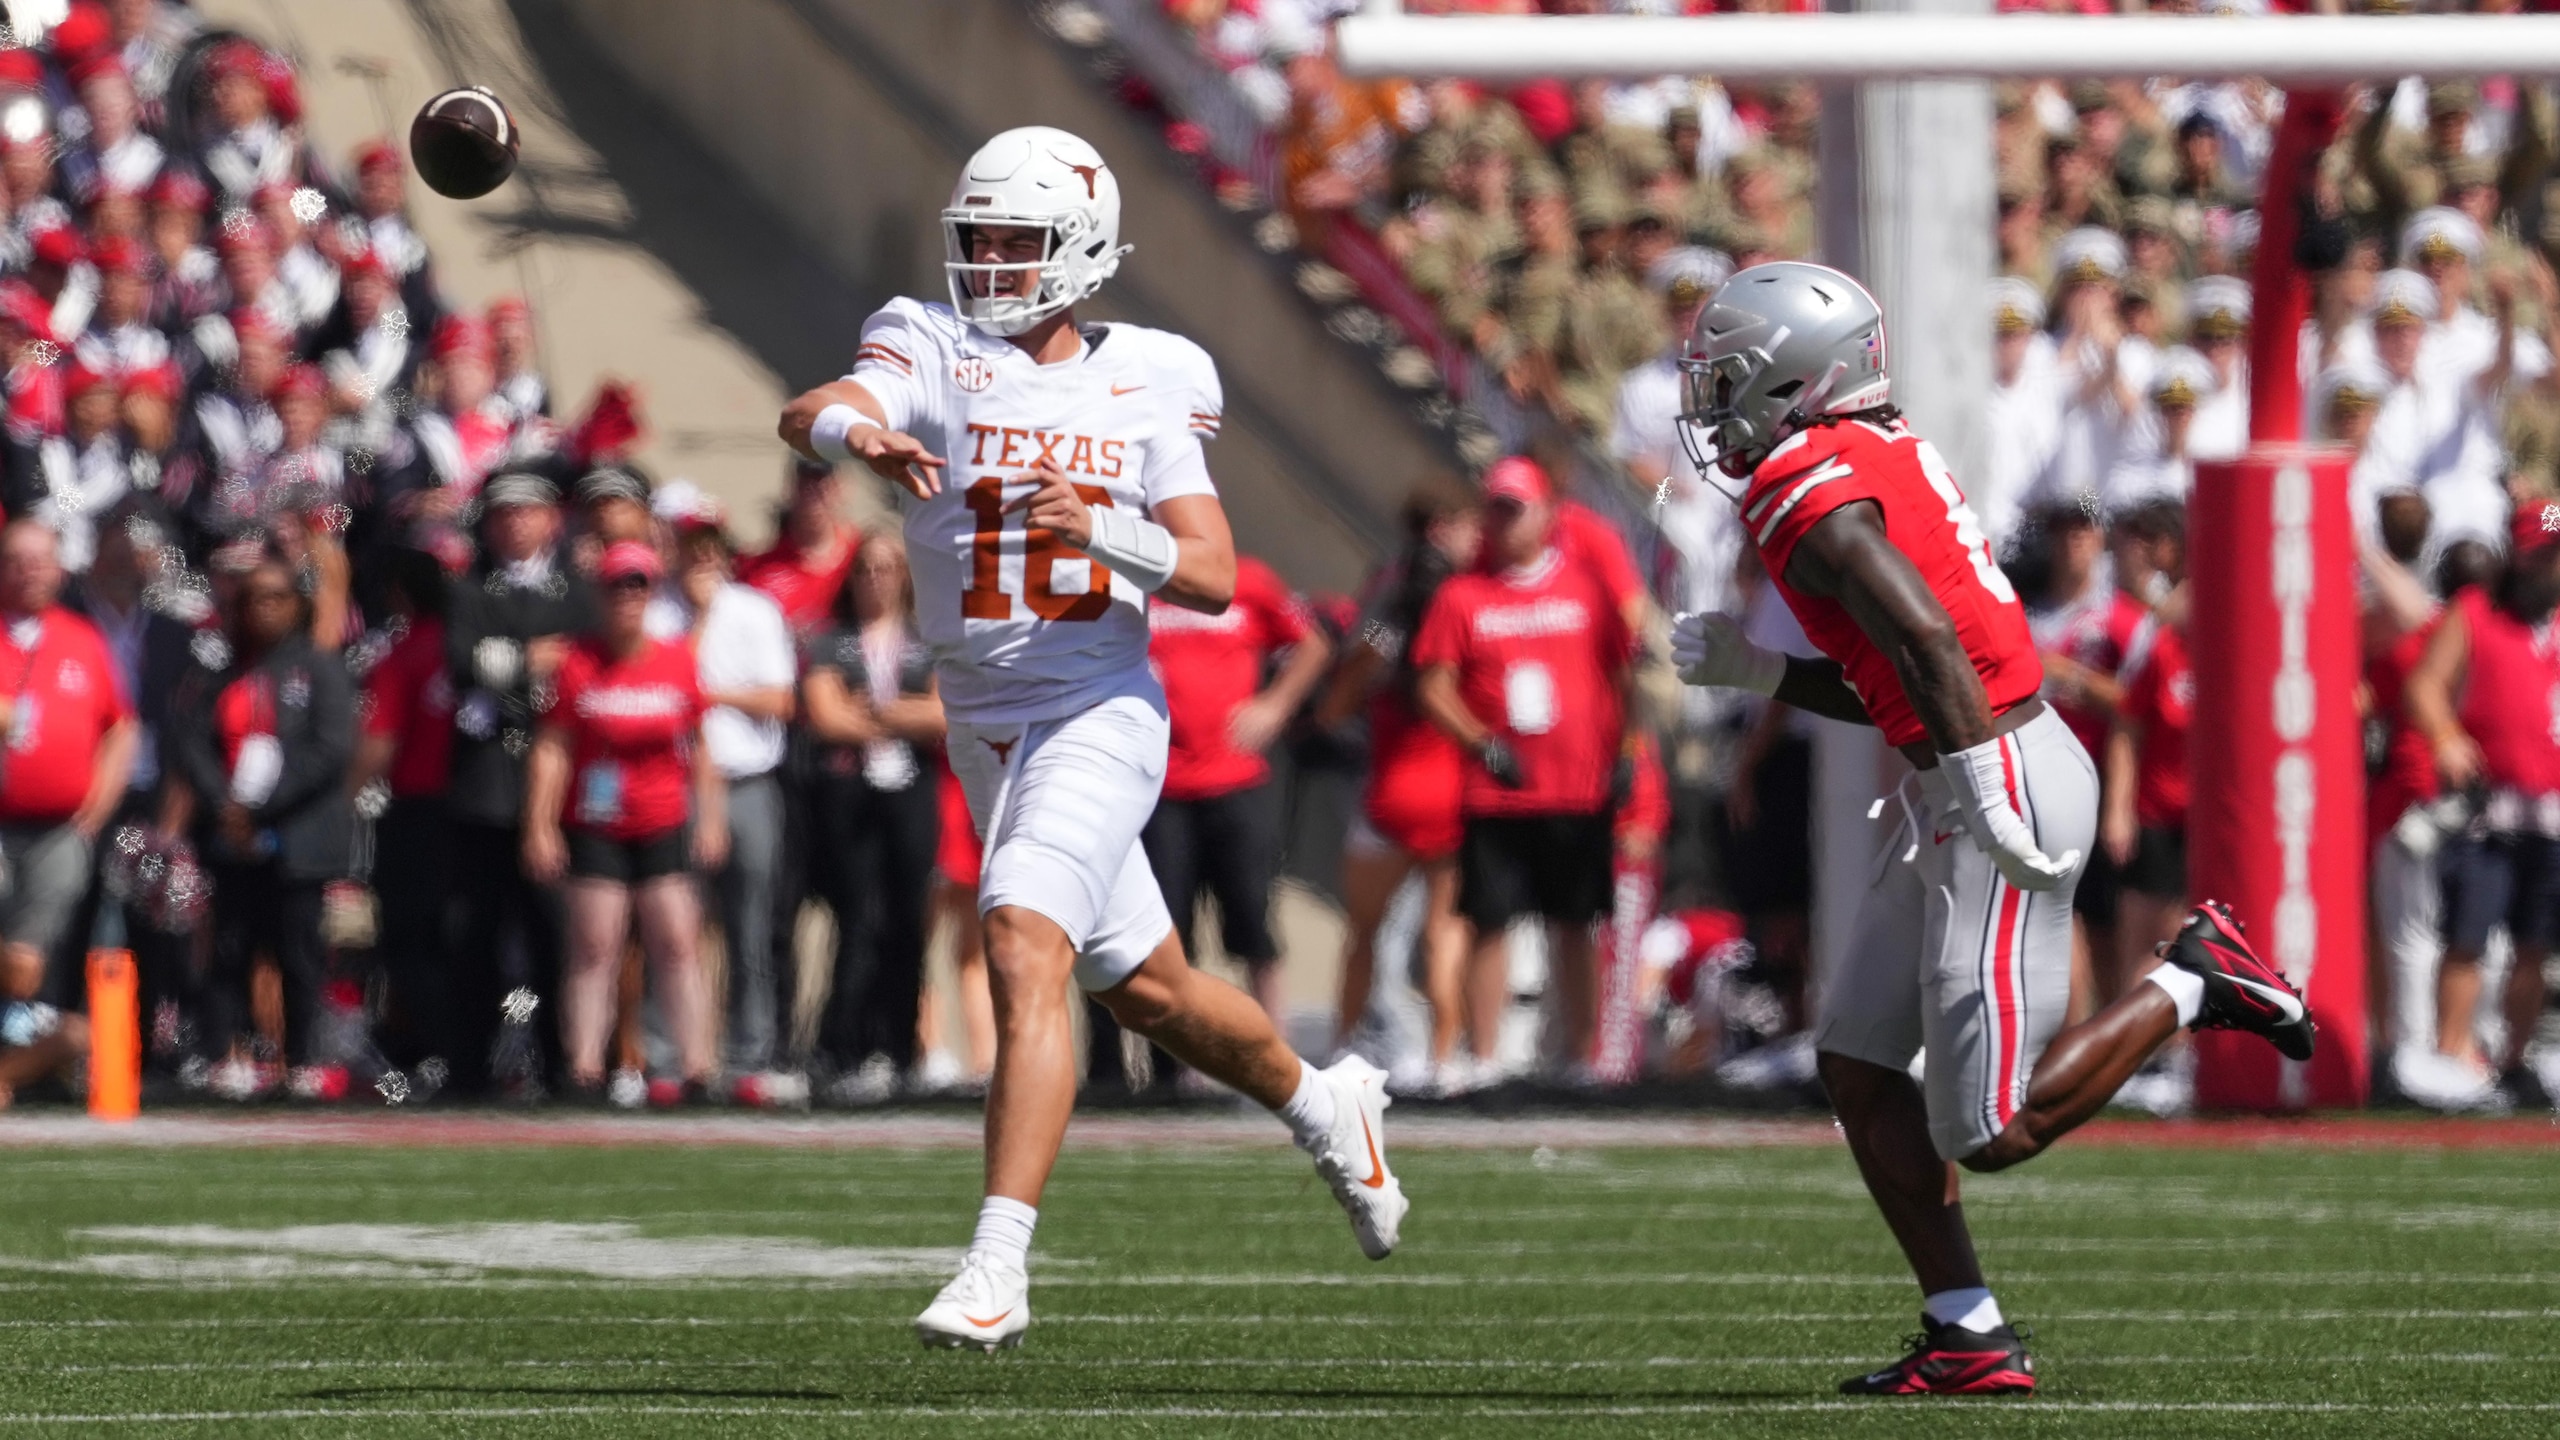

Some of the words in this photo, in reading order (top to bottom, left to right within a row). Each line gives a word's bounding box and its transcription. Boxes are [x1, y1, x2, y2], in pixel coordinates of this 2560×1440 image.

[957, 357, 992, 392] SEC
[967, 423, 1124, 478] TEXAS
[961, 476, 1114, 622] 16
